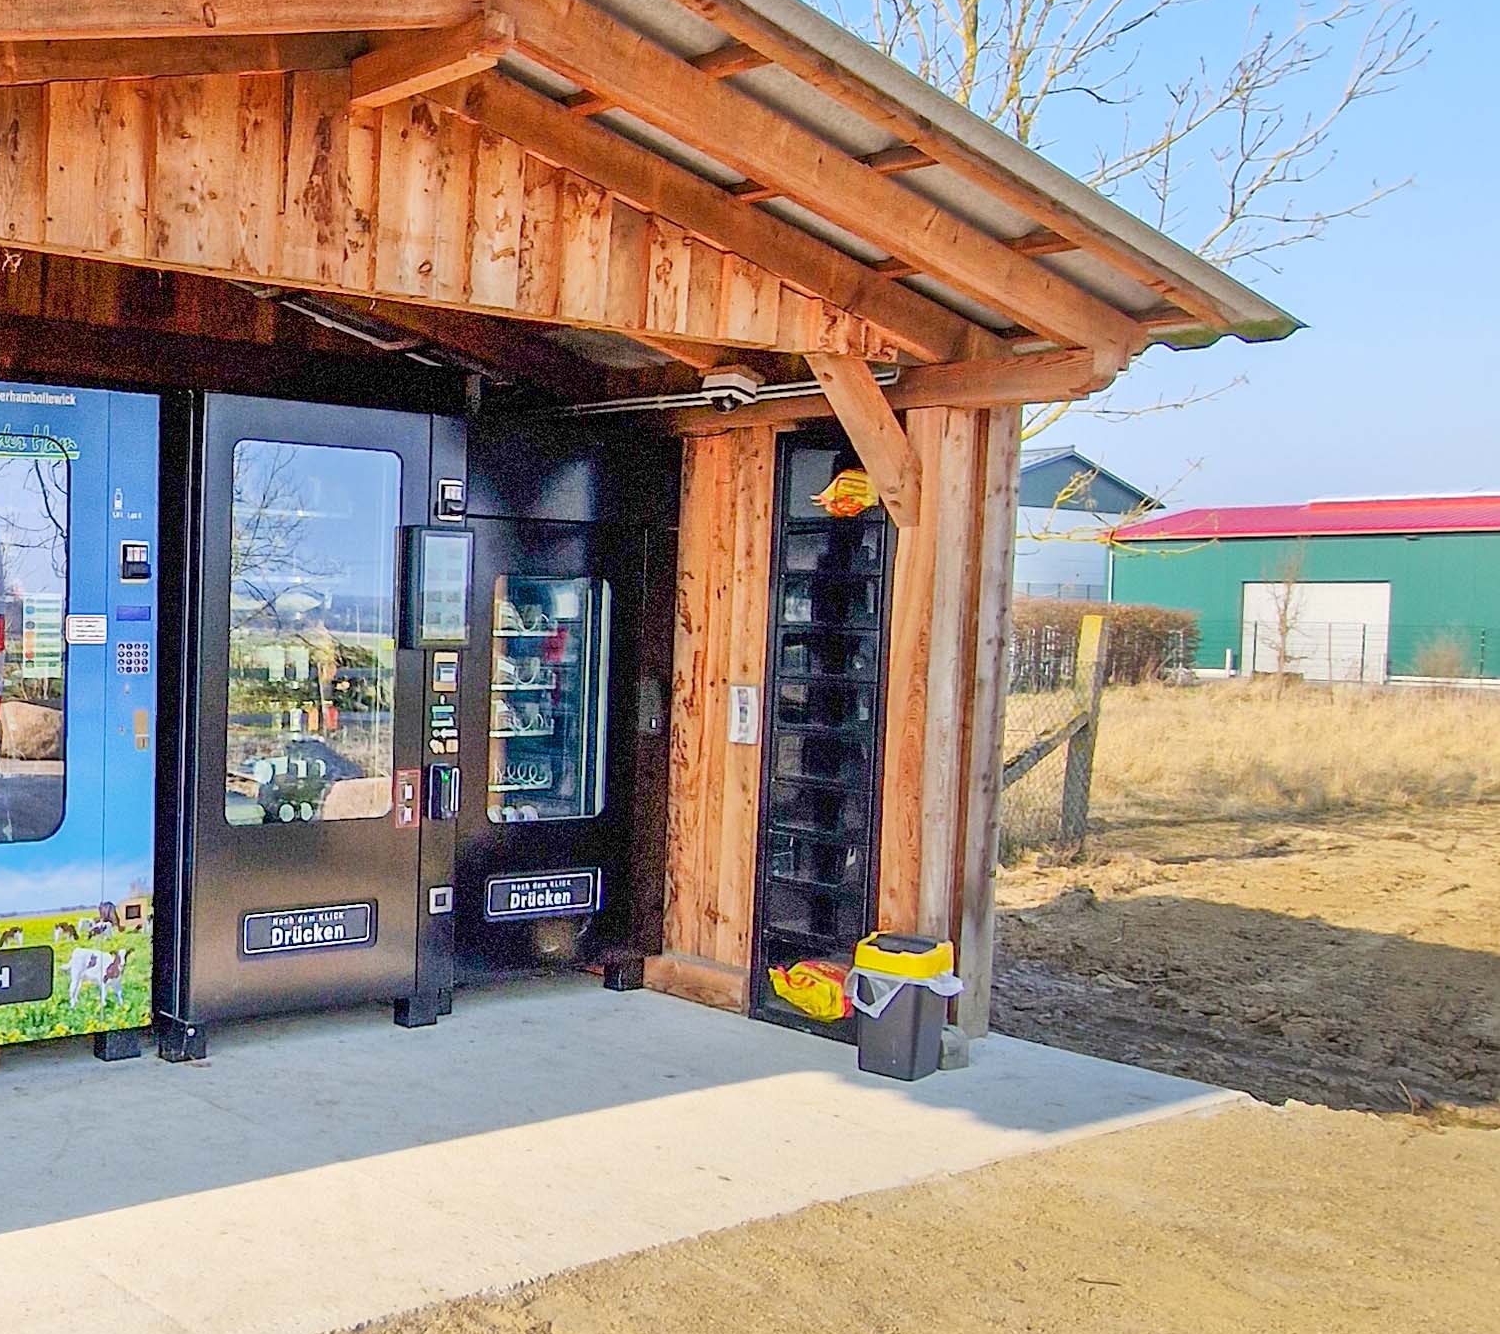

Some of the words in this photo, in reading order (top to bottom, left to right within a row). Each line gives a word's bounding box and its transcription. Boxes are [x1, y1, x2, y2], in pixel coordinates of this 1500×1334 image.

[31, 424, 78, 452] Ham
[510, 889, 571, 909] Drücken
[271, 922, 346, 946] Drücken
